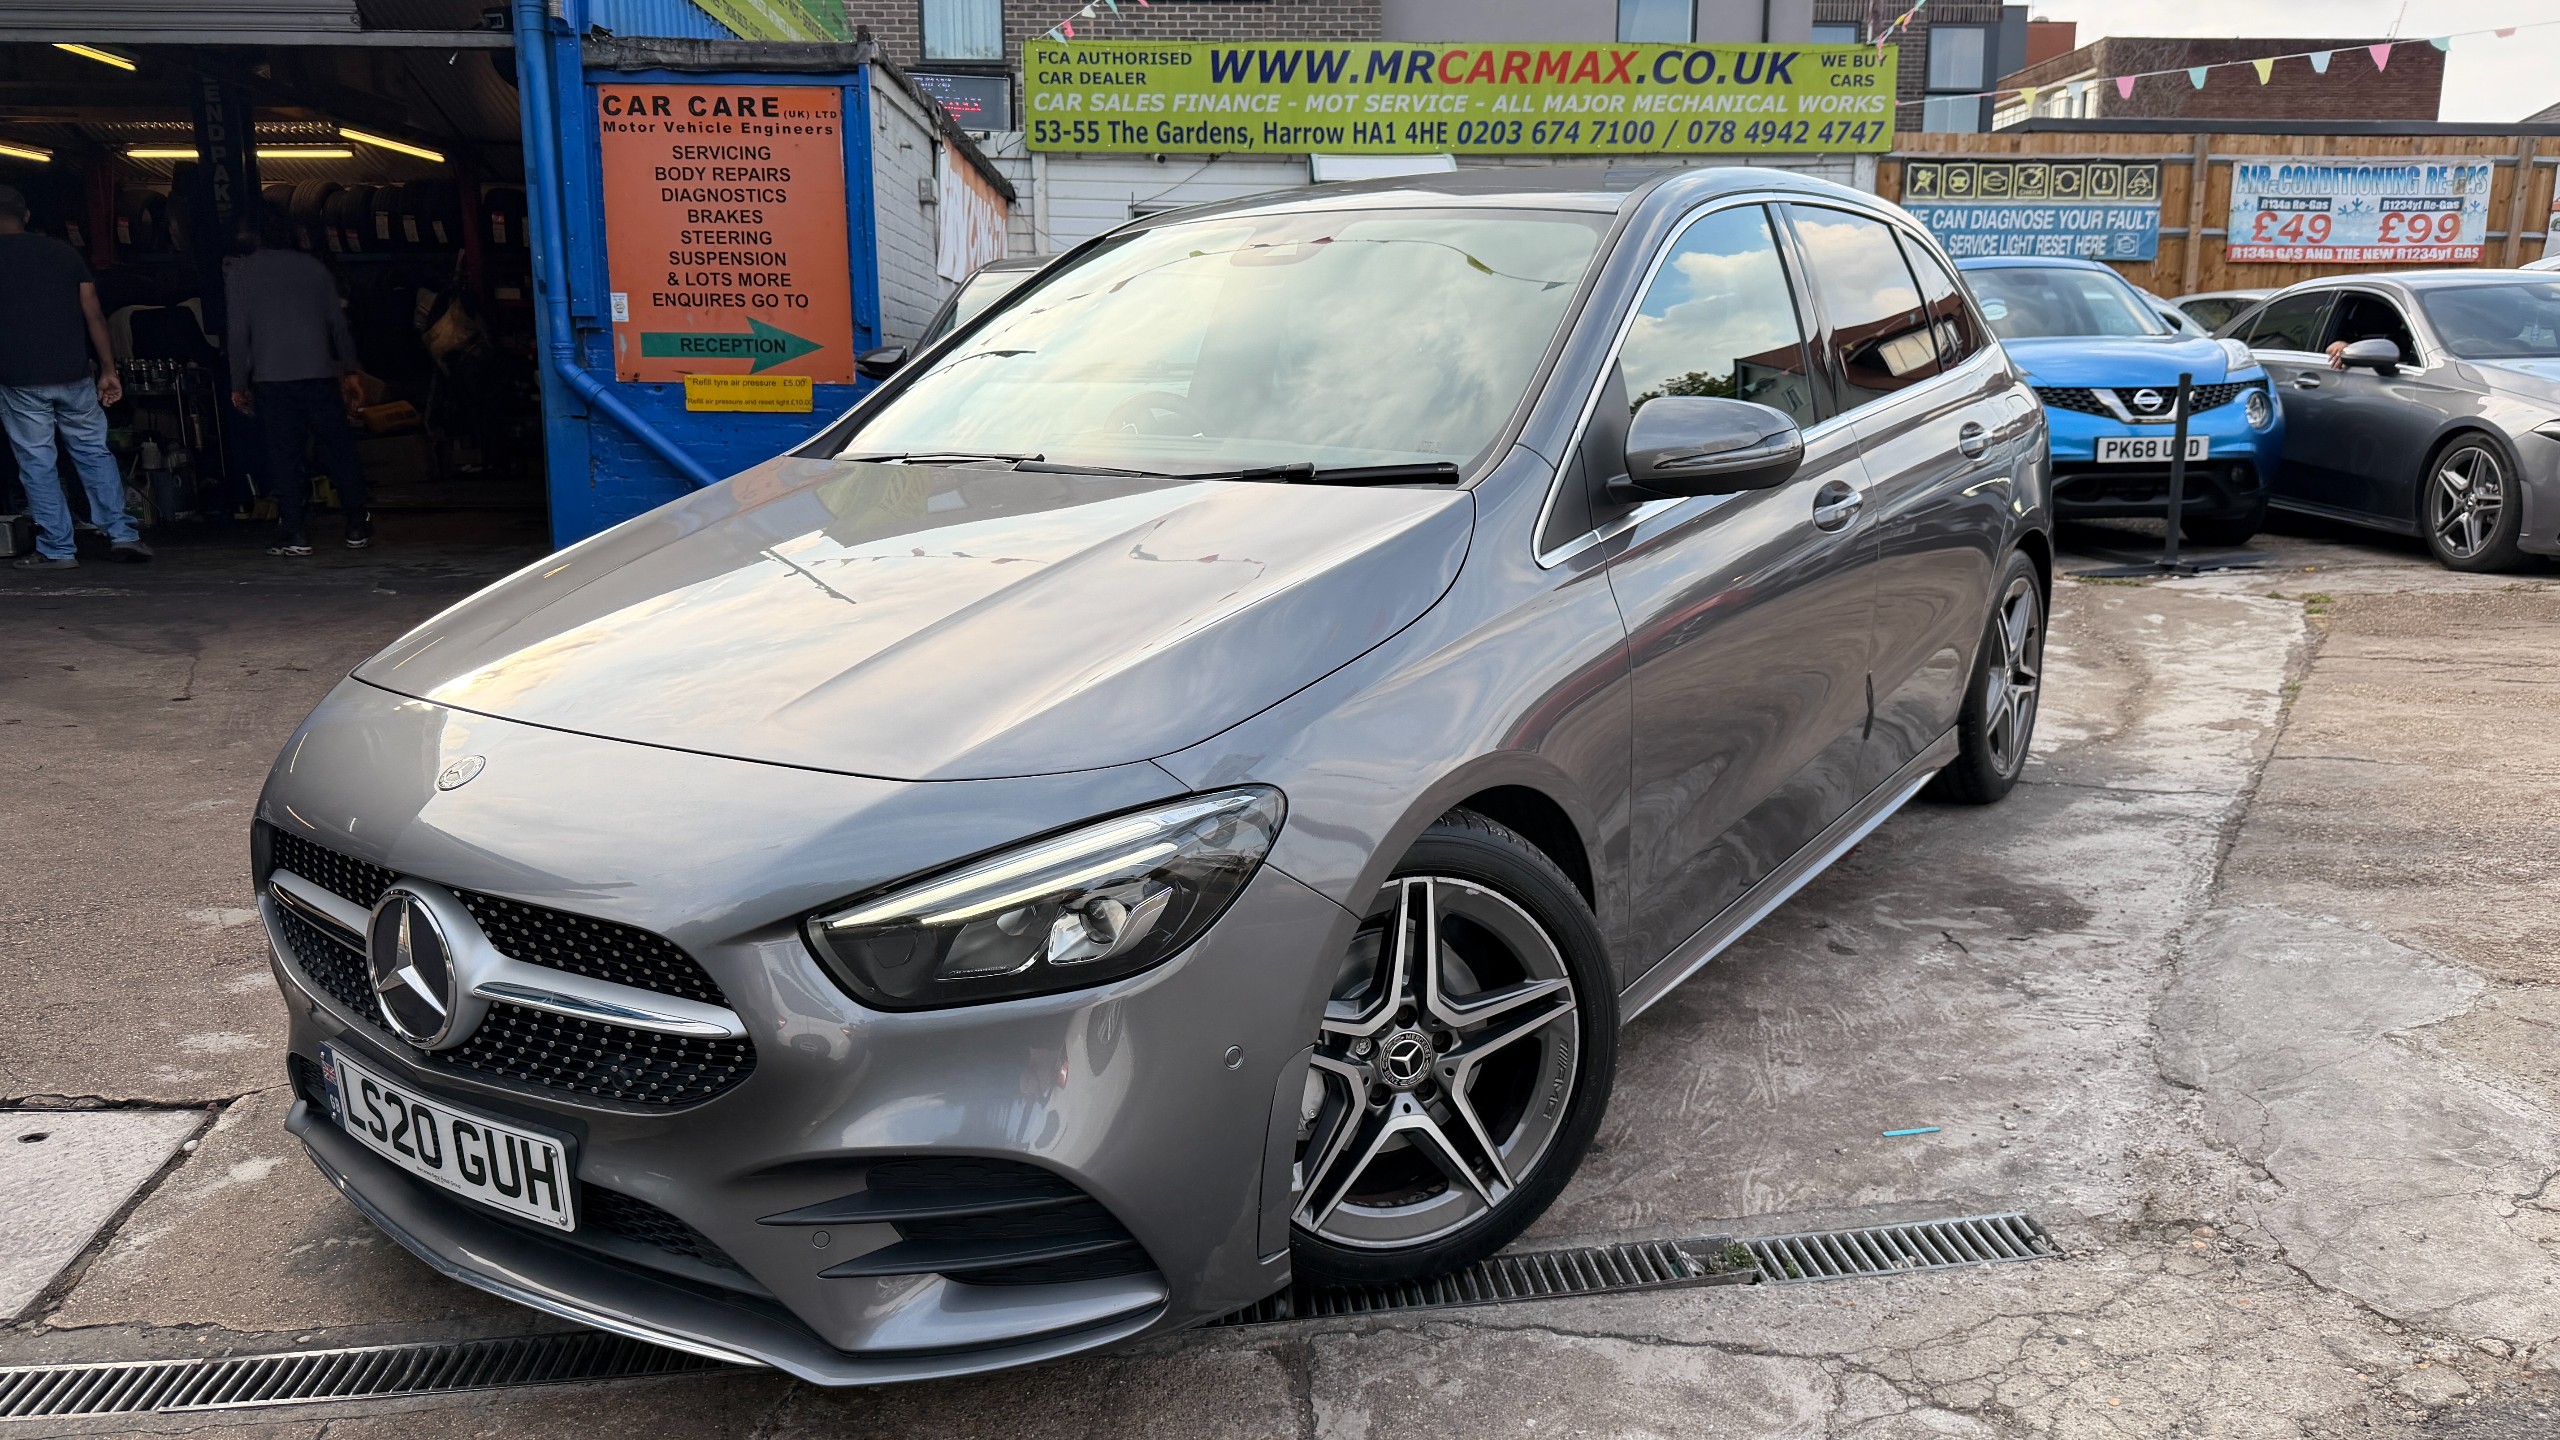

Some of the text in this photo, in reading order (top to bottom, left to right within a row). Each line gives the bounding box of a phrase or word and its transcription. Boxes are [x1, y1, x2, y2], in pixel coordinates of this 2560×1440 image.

[1038, 51, 1193, 66] FCA AUTHORISED
[1820, 54, 1888, 68] WE BUY
[1210, 49, 1801, 85] WWW.MRCARMAX.CO.UK
[1038, 71, 1147, 86] CAR DEALER
[1830, 73, 1875, 88] CARS
[602, 95, 837, 121] CAR CARE (UK) LTD
[1033, 93, 1085, 112] CAR
[1089, 93, 1165, 113] SALES
[1172, 93, 1281, 113] FINANCE
[1304, 93, 1358, 113] MOT
[1364, 93, 1468, 114] SERVICE
[1492, 94, 1535, 114] ALL
[1542, 94, 1624, 114] MAJOR
[1632, 94, 1788, 114] MECHANICAL
[1798, 94, 1885, 114] WORKS
[603, 121, 834, 137] Motor Vehicle Engineers
[1034, 120, 1885, 149] 53-55 The Gardens, Harrow HA1 4HE 0203 674 7100 / 078 4942 4747
[672, 145, 772, 161] SERVICING
[655, 167, 791, 182] BODY REPAIRS
[2425, 166, 2488, 195] RE-GAS
[661, 188, 787, 203] DIAGNOSTICS
[2261, 199, 2329, 210] R134a Re-Gas
[2382, 200, 2460, 211] R1234yf Re-Gas
[687, 209, 763, 224] BRAKES
[1932, 209, 1968, 229] CAN
[1970, 209, 2054, 229] DIAGNOSE
[2059, 210, 2103, 230] YOUR
[2105, 210, 2157, 230] FAULT
[2251, 212, 2332, 243] £49
[2378, 212, 2460, 243] £99
[680, 230, 773, 245] STEERING
[1949, 234, 2108, 256] SERVICE LIGHT RESET HERE
[669, 251, 787, 266] SUSPENSION
[2231, 247, 2480, 260] R134a GAS AND THE NEW R1234yf GAS
[667, 272, 791, 287] & LOTS MORE
[653, 292, 809, 308] ENQUIRES GO TO
[680, 338, 786, 353] RECEPTION
[692, 378, 712, 386] Refill
[714, 379, 729, 388] tyre
[743, 380, 777, 388] pressure
[783, 379, 806, 387] £5.00
[2106, 439, 2200, 458] PK68 UD
[1405, 1033, 1431, 1058] MERCEDES
[1384, 1070, 1400, 1085] BENZ
[329, 1093, 341, 1114] GB
[338, 1062, 561, 1213] LS20 GUH
